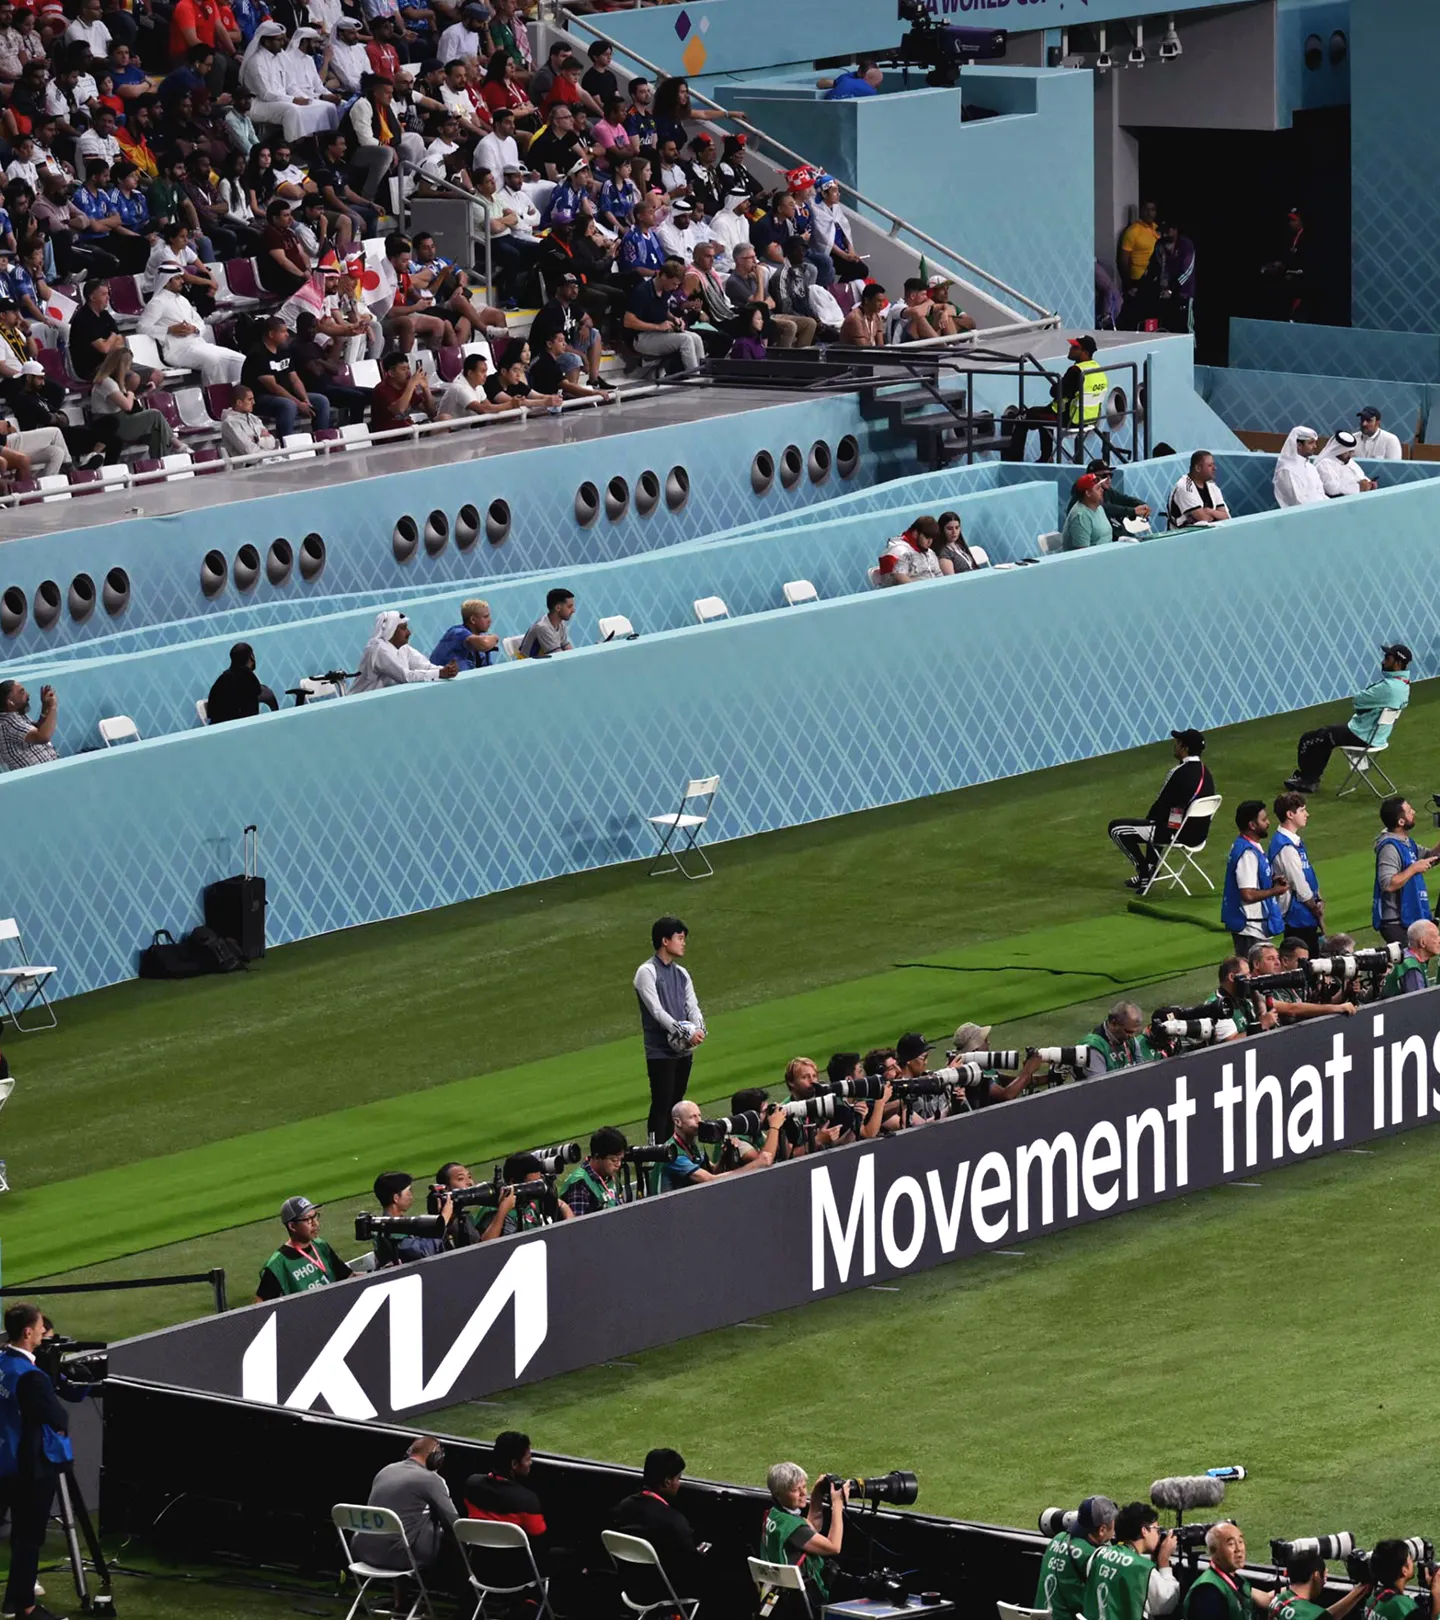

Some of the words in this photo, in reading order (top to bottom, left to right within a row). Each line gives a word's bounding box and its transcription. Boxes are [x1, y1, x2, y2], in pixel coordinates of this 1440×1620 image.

[811, 1075, 1197, 1292] Movement
[1213, 1032, 1353, 1174] that
[292, 1262, 319, 1282] PHO
[348, 1509, 385, 1530] LED
[1097, 1546, 1134, 1566] PHOTO
